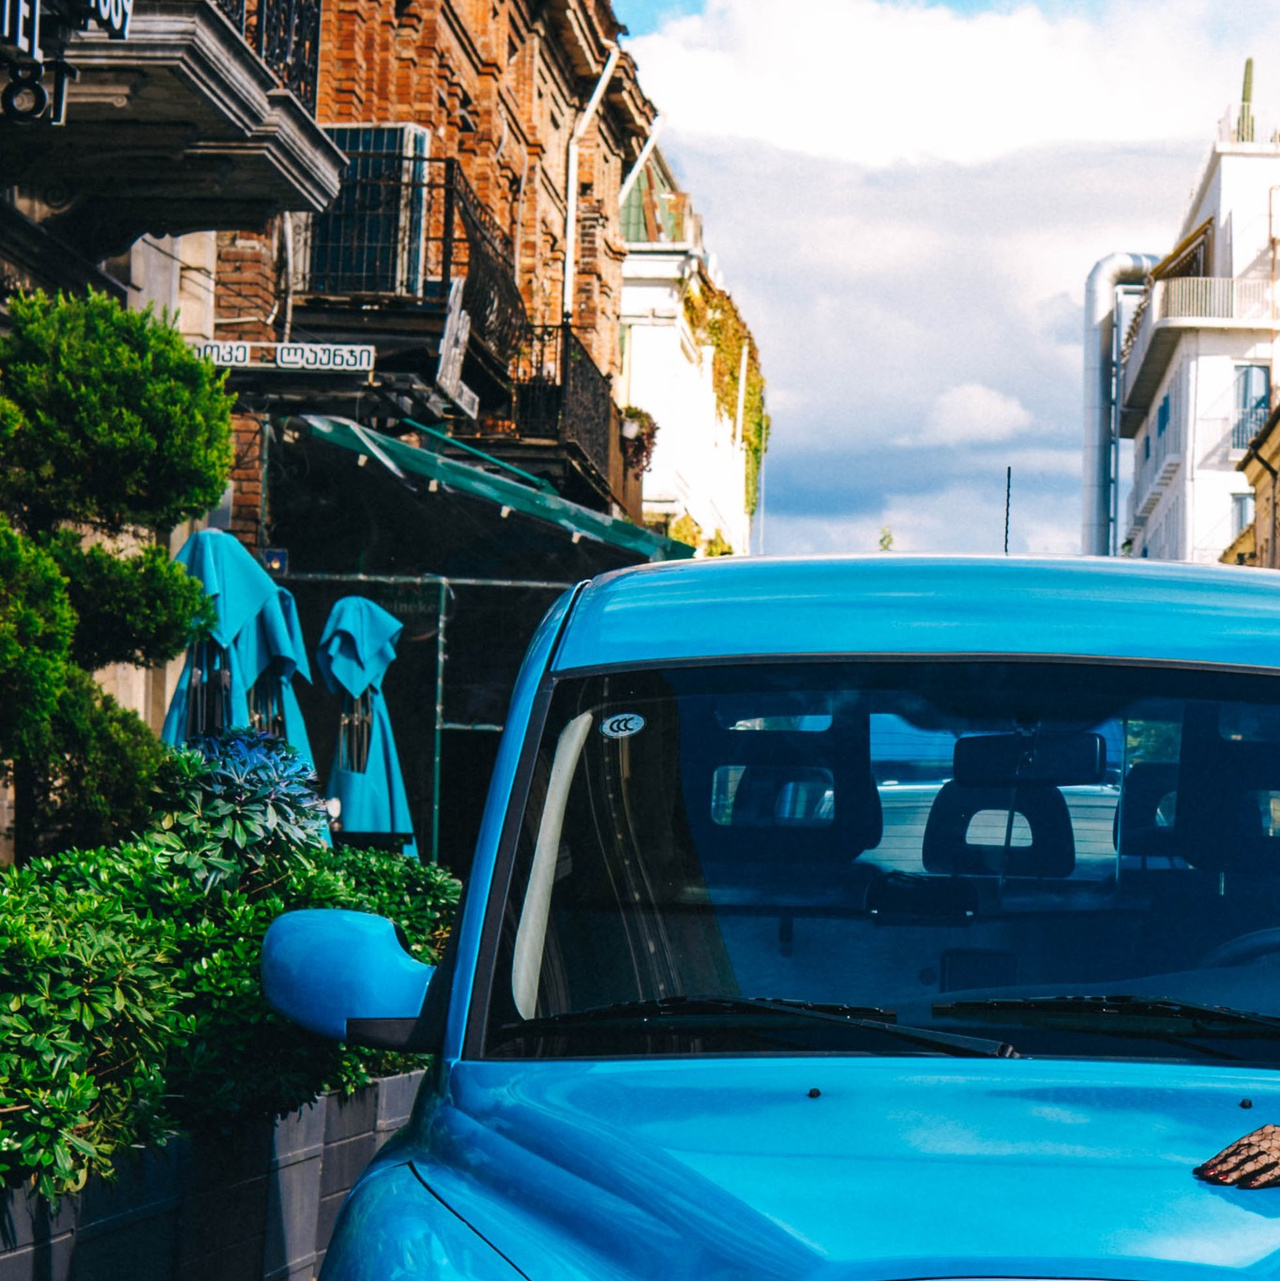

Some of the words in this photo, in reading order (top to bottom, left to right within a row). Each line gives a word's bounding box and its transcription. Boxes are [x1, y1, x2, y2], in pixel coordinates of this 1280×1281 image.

[197, 344, 248, 363] ოკე
[279, 346, 372, 368] ლაუნჯი
[609, 717, 634, 732] CCC
